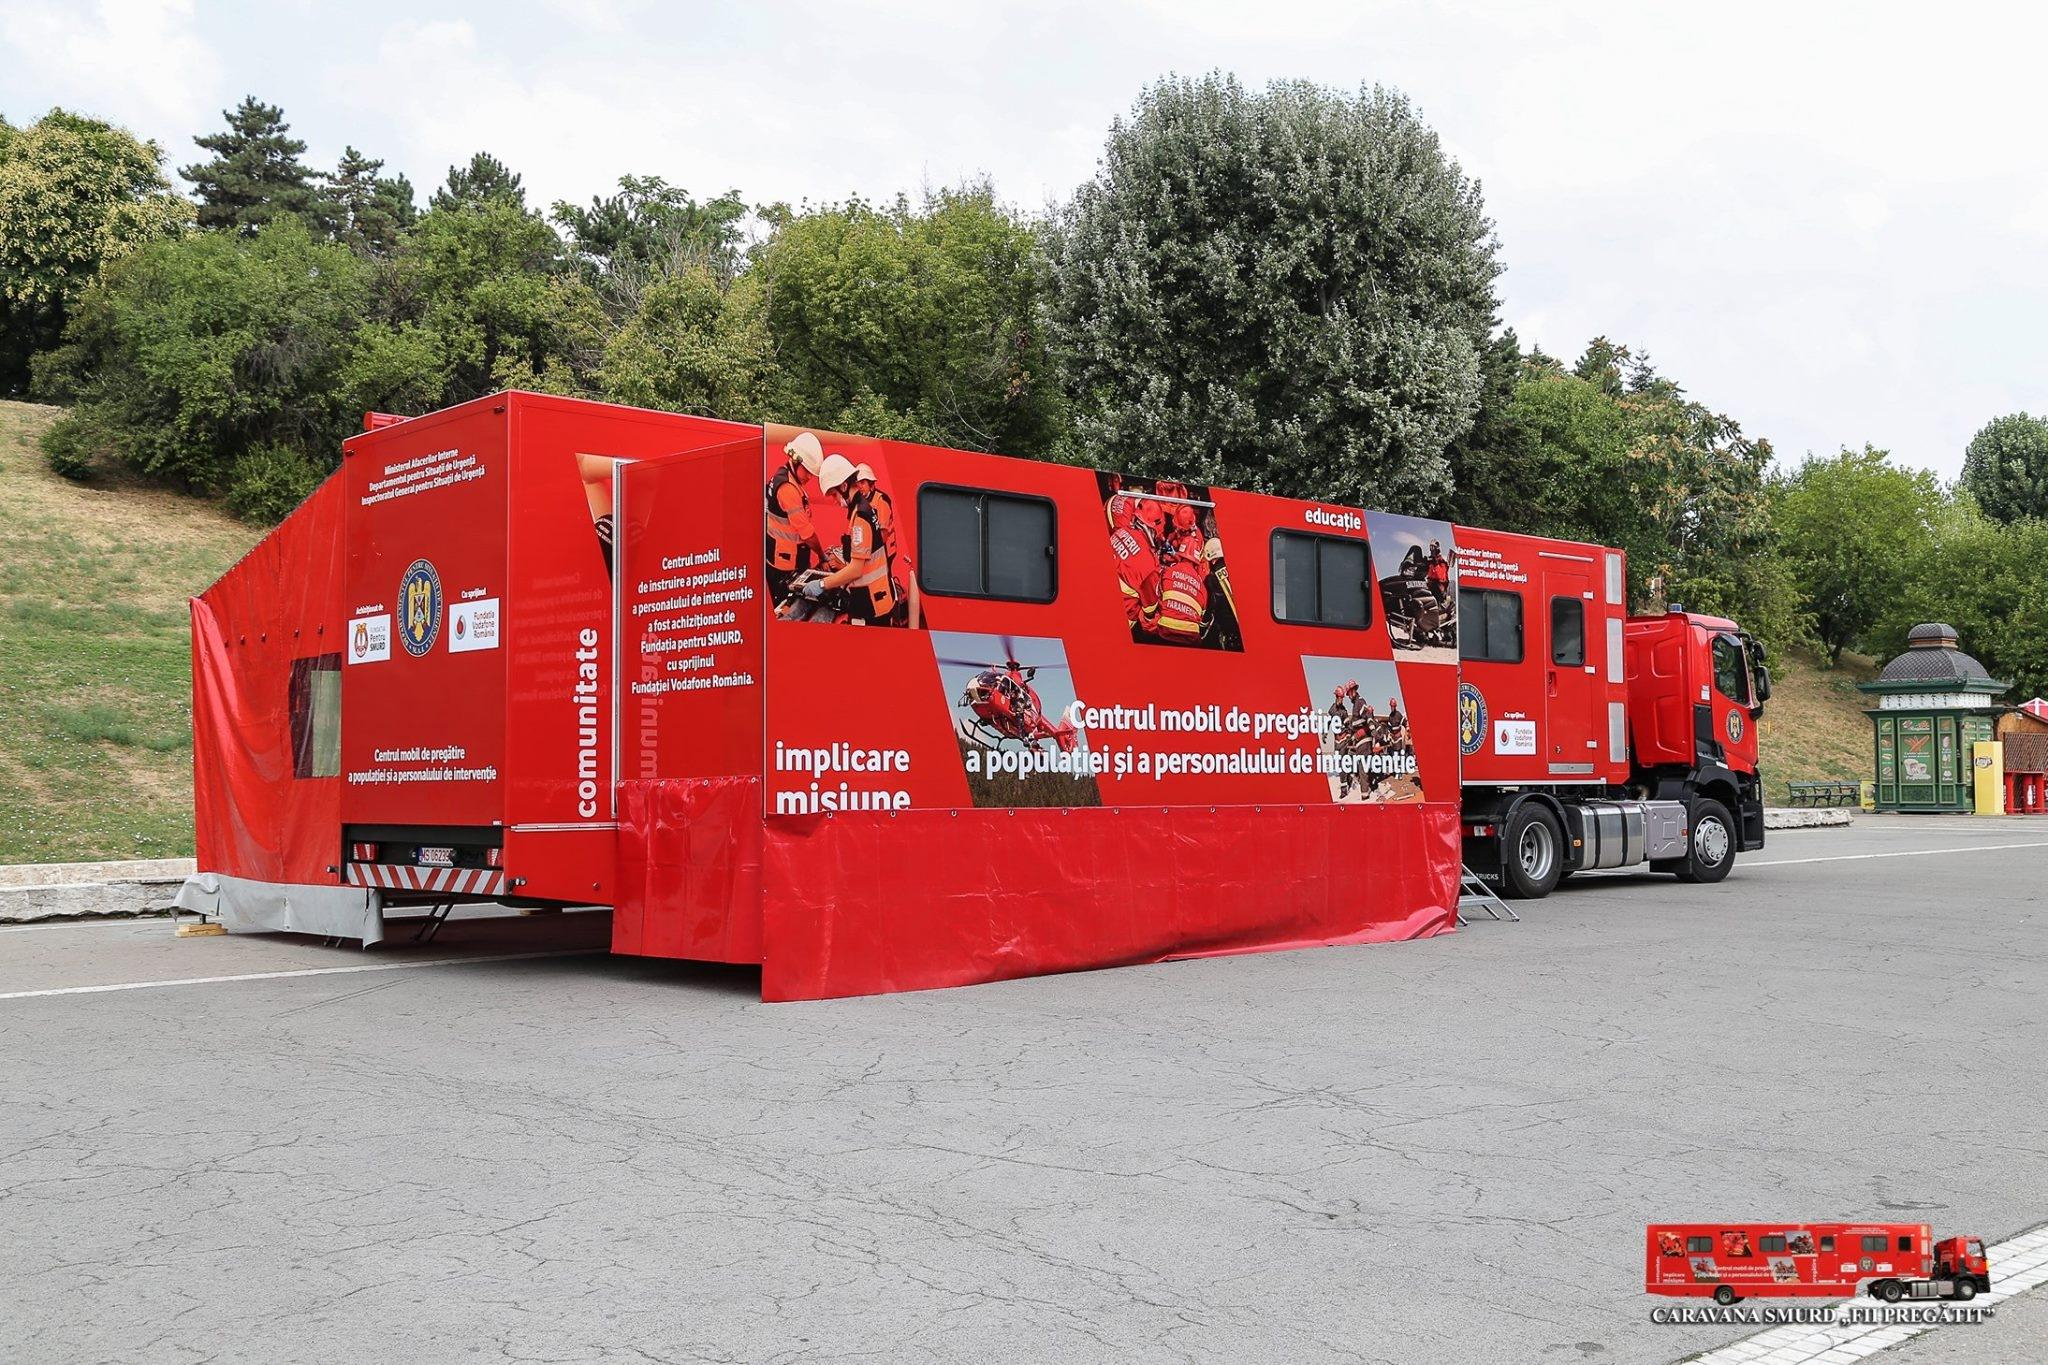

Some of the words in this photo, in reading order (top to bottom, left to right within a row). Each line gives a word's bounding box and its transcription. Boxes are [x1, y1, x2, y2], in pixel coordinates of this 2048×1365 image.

[445, 462, 453, 471] de
[454, 472, 461, 483] de
[1305, 507, 1362, 532] educație
[662, 553, 694, 571] Centrul
[695, 548, 720, 565] mobil
[638, 581, 649, 594] de
[649, 575, 685, 592] instruire
[686, 578, 692, 588] a
[692, 567, 737, 589] populației
[738, 565, 747, 582] și
[632, 604, 638, 615] a
[638, 593, 690, 616] personalului
[691, 593, 702, 607] de
[703, 586, 754, 603] intervenție
[648, 622, 653, 633] a
[653, 619, 671, 632] fost
[671, 612, 723, 630] achiziționat
[723, 610, 736, 623] de
[641, 637, 677, 654] Fundația
[678, 636, 707, 652] pentru
[707, 630, 744, 646] SMURD,
[666, 660, 677, 672] cu
[678, 654, 715, 673] sprijinul
[631, 678, 670, 696] Fundației
[670, 675, 712, 692] Vodafone
[712, 672, 754, 688] România.
[572, 628, 598, 818] comunitate
[1070, 700, 1156, 731] Centrul
[1160, 704, 1222, 734] mobil
[1226, 706, 1251, 734] de
[1255, 707, 1343, 740] pregătire
[374, 748, 400, 763] Centrul
[400, 747, 421, 761] mobil
[421, 747, 431, 761] de
[431, 745, 465, 763] pregătire
[776, 741, 910, 779] implicare
[966, 749, 981, 773] a
[987, 745, 1109, 781] populației
[1114, 745, 1133, 781] și
[1137, 752, 1150, 774] a
[1155, 747, 1286, 781] personalului
[1289, 748, 1313, 775] de
[1316, 747, 1418, 780] intervenție
[348, 772, 353, 783] a
[353, 768, 386, 786] populației
[386, 768, 393, 785] și
[393, 772, 398, 781] a
[398, 767, 443, 784] personalului
[443, 767, 453, 781] de
[453, 765, 497, 783] intervenție
[776, 782, 911, 814] misiune
